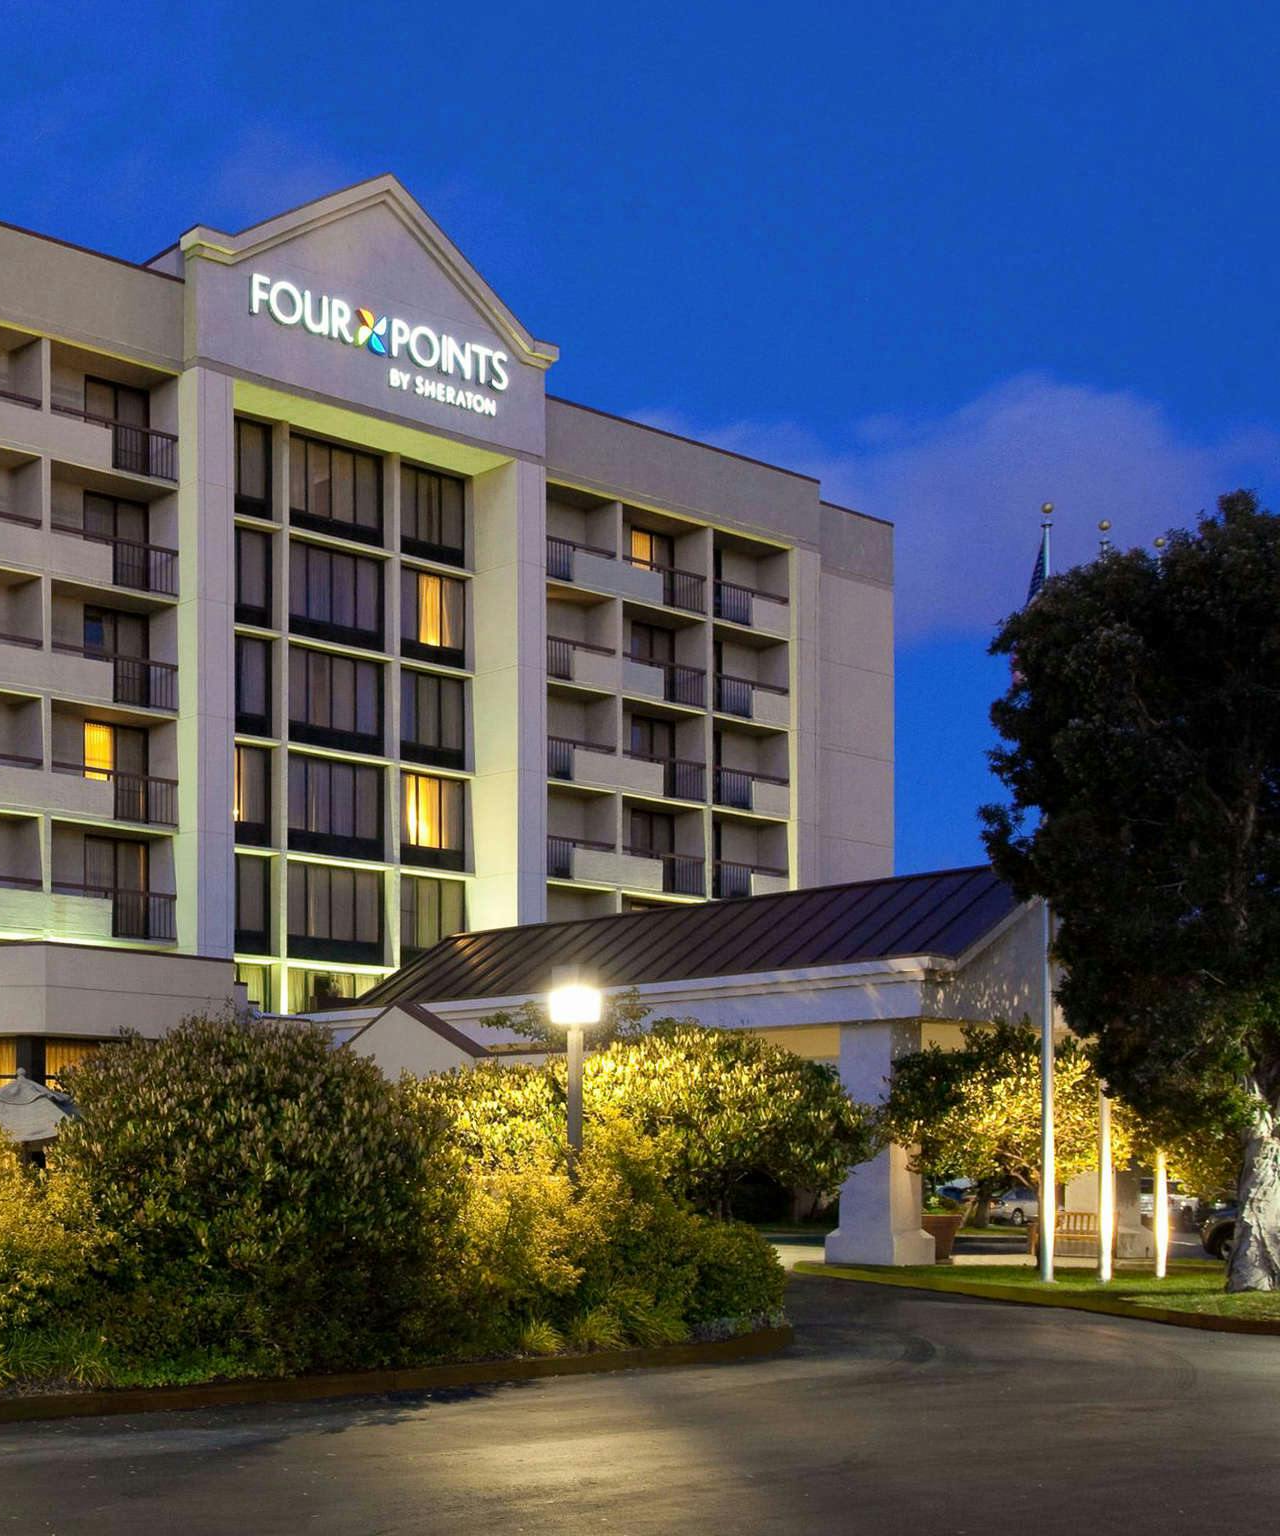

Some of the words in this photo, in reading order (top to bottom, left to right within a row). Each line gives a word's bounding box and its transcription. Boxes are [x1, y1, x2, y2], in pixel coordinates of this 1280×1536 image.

[250, 272, 354, 343] FOUR
[388, 317, 510, 391] POINTS
[388, 367, 412, 390] BY
[414, 376, 497, 417] SHERATON
